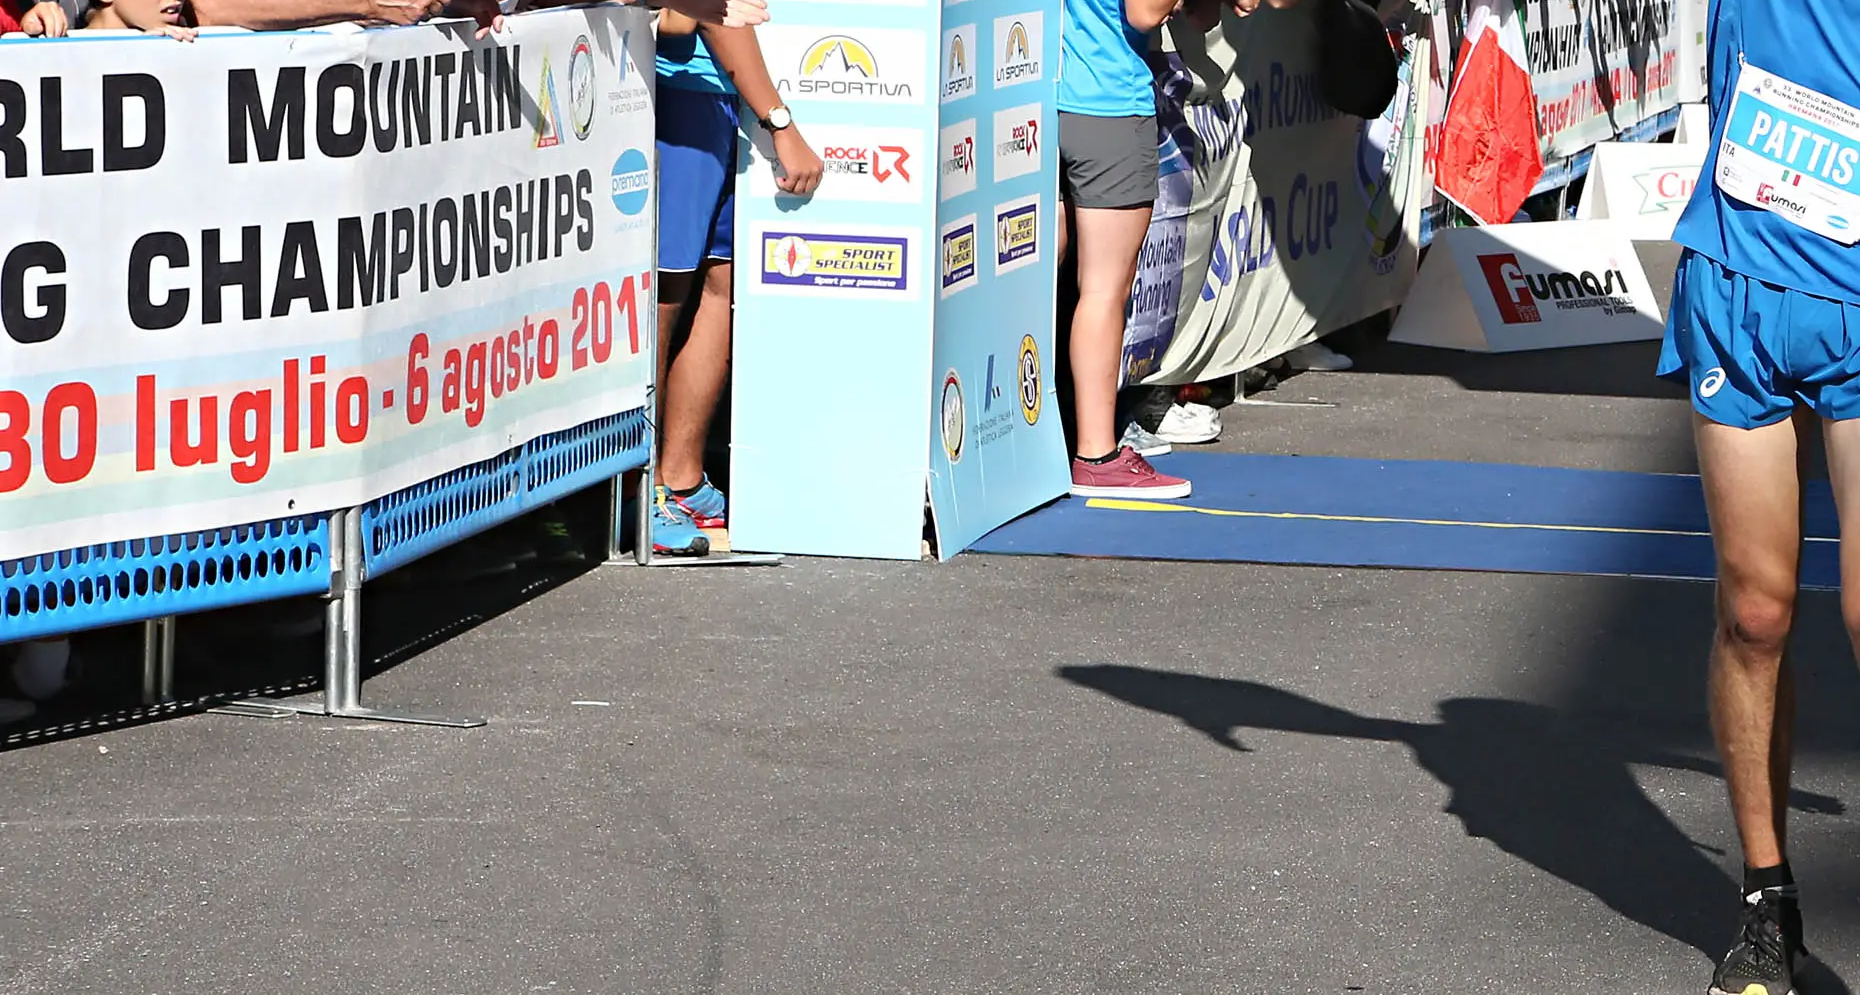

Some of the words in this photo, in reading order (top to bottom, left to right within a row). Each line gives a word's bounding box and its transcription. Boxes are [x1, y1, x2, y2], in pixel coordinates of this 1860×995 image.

[1005, 61, 1040, 82] SPORTIVA
[799, 80, 912, 98] SPORTIVA
[0, 72, 167, 179] RLD
[227, 44, 523, 165] MOUNTAIN
[1772, 88, 1805, 106] RUNNING
[1804, 101, 1860, 130] CHAMPIONSHIPS
[1794, 89, 1821, 104] WORLD
[1820, 98, 1856, 119] MOUNTAIN
[824, 146, 869, 160] ROCK
[1722, 141, 1736, 158] ITA
[1747, 110, 1860, 186] PATTIS
[1286, 172, 1339, 261] CUP
[127, 167, 594, 331] CHAMPIONSHIPS
[842, 248, 897, 261] SPORT
[815, 259, 896, 272] SPECIALIST
[1555, 298, 1609, 310] PROFESSIONAL
[0, 380, 98, 493] 30
[135, 354, 370, 485] luglio
[406, 331, 430, 426] 6
[441, 313, 559, 428] agosto
